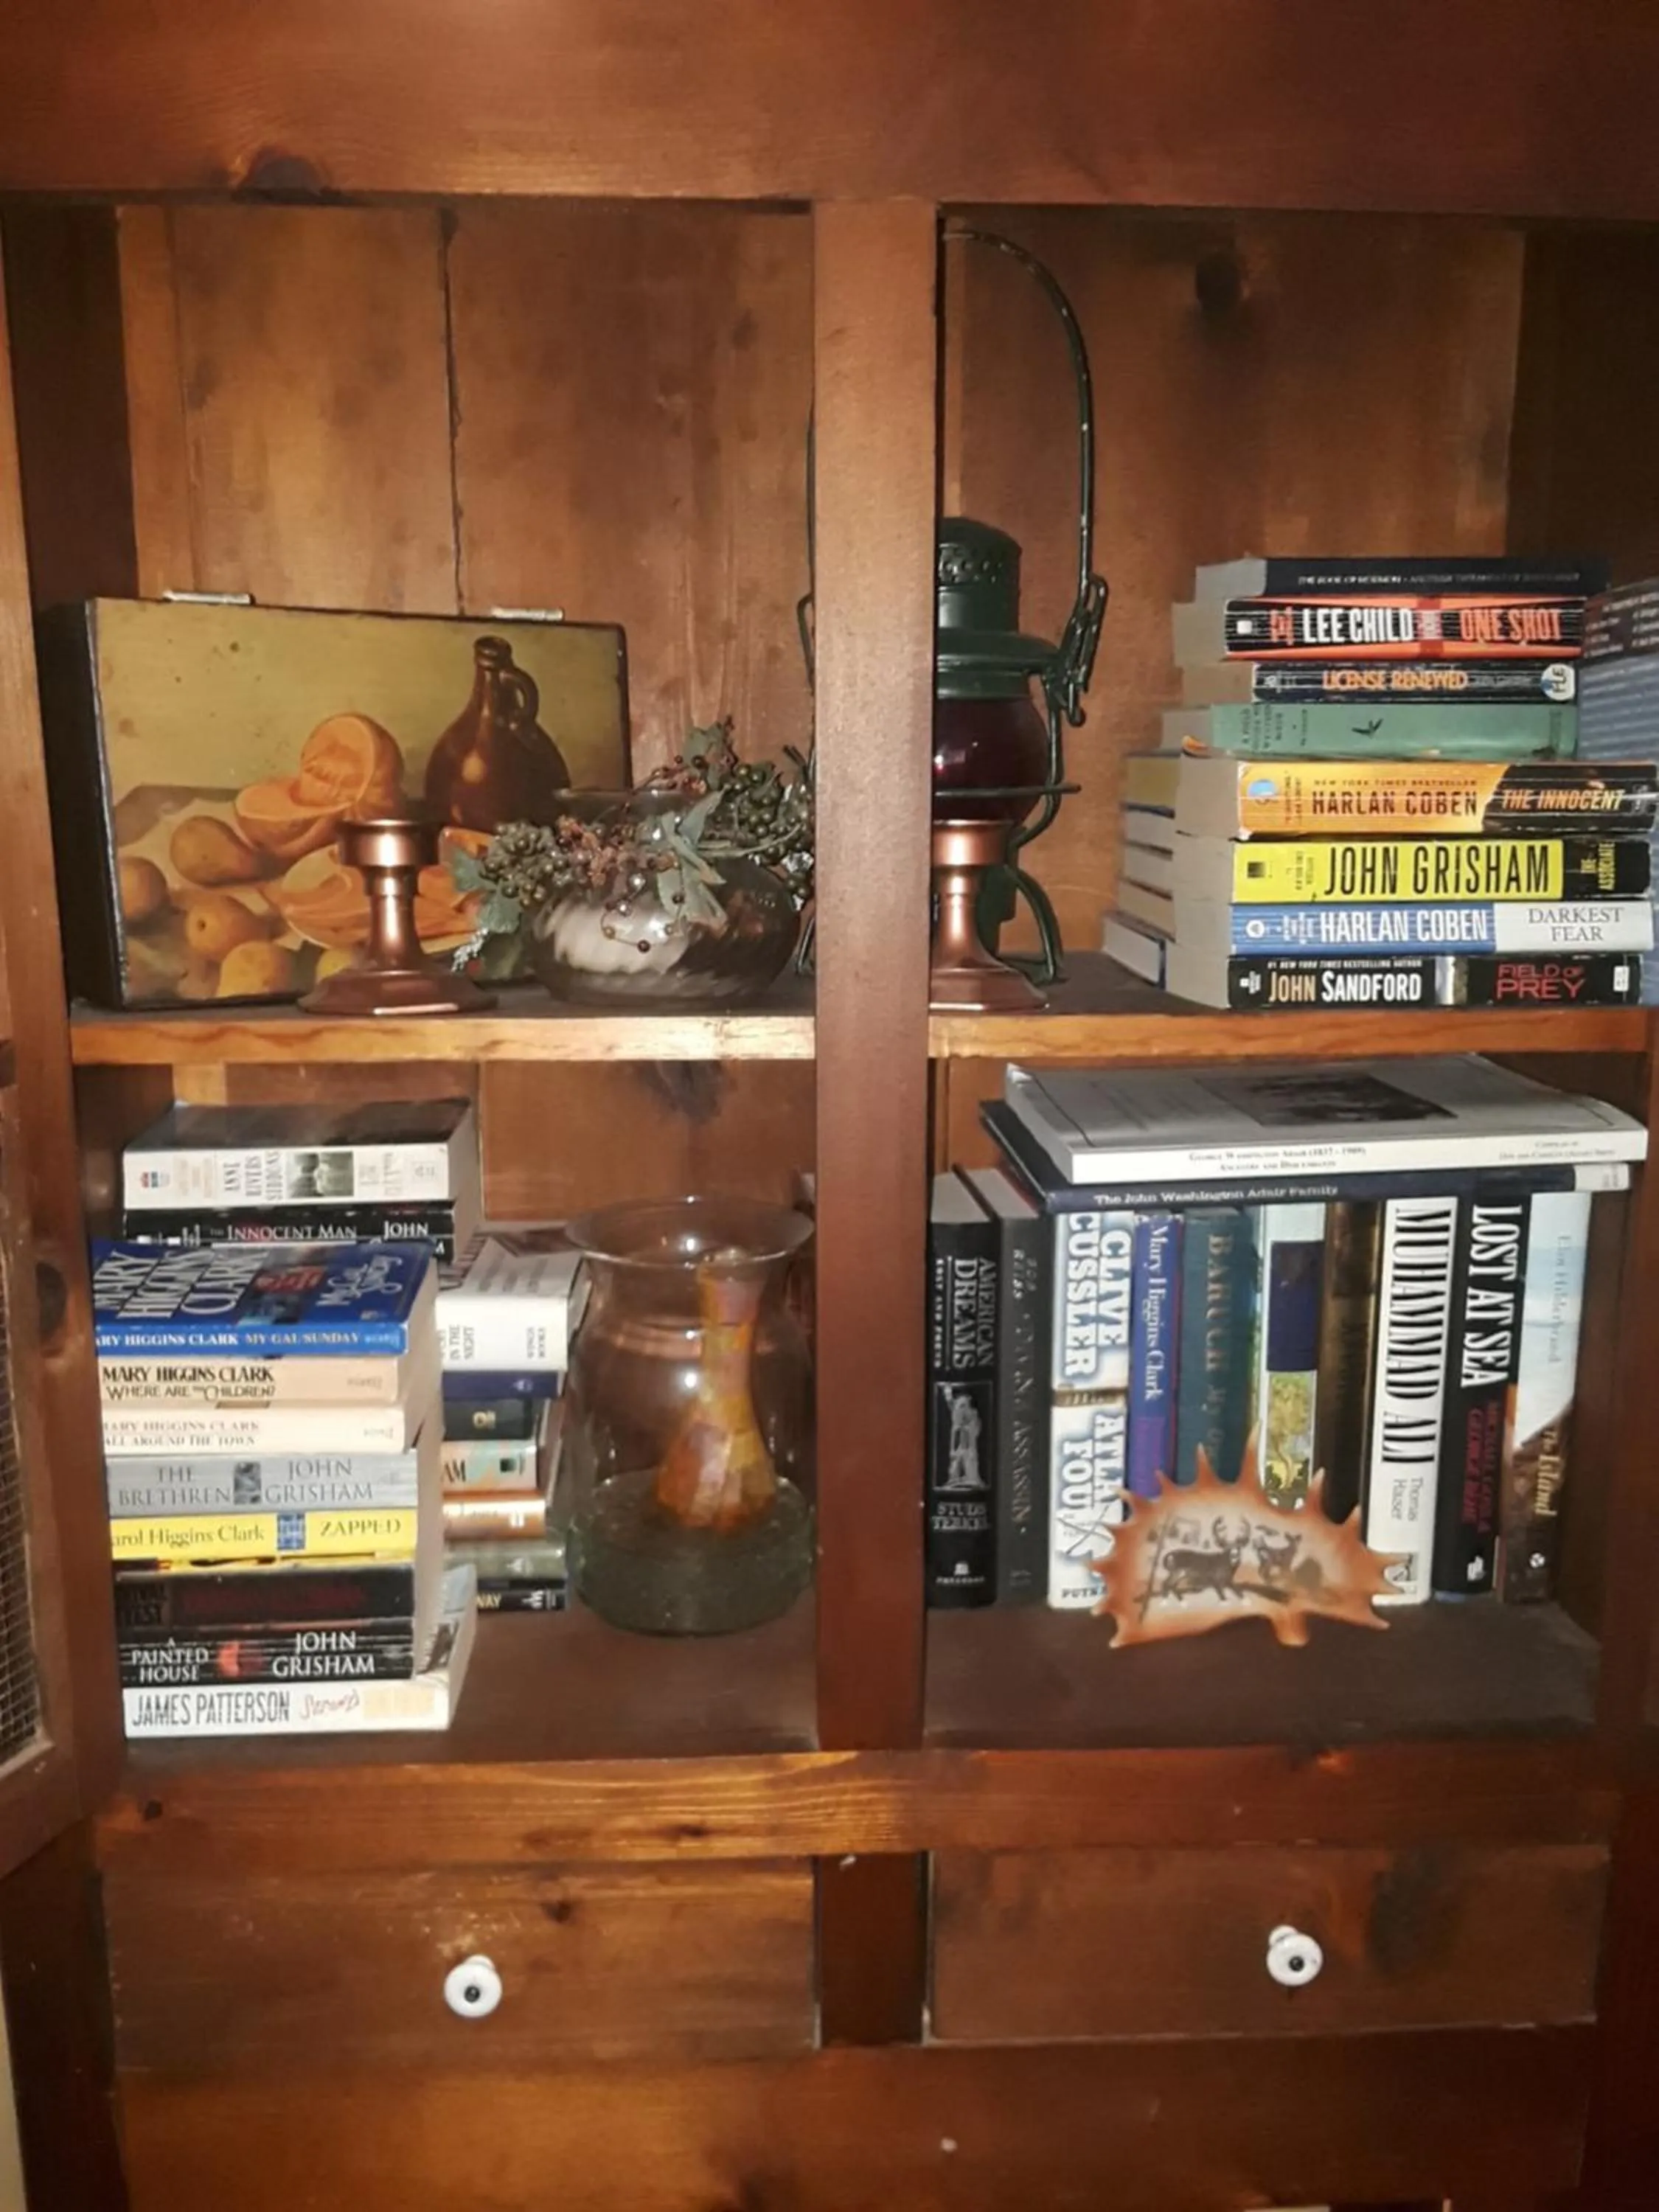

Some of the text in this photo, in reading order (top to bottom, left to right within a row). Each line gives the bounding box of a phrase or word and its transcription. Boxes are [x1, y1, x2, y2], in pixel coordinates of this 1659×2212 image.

[1302, 608, 1346, 644] LEE
[1349, 608, 1414, 643] CHILD
[1459, 609, 1504, 641] ONE
[1508, 609, 1562, 641] SHOT
[1322, 670, 1387, 689] LICENSE
[1391, 669, 1469, 690] RENEWED
[1312, 790, 1395, 815] HARLAN
[1405, 790, 1478, 816] COBEN
[1501, 789, 1534, 810] THE
[1536, 788, 1625, 811] INNOCENT
[1324, 846, 1399, 896] JOHN
[1412, 845, 1548, 894] GRISHAM
[1580, 858, 1596, 874] THE
[1598, 842, 1615, 891] ASSOCIATE
[1321, 911, 1408, 943] HARLAN
[1416, 909, 1488, 942] COBEN
[1528, 907, 1624, 924] DARKEST
[1551, 925, 1604, 942] FEAR
[1498, 964, 1560, 978] FIELD
[1268, 971, 1316, 1002] JOHN
[1321, 970, 1422, 1003] SANDFORD
[1496, 978, 1586, 999] PREY
[1093, 1194, 1122, 1206] The
[1125, 1192, 1158, 1204] John
[1160, 1189, 1244, 1203] Washington
[1289, 1185, 1338, 1196] Family
[227, 1224, 313, 1240] INNOCENT
[318, 1223, 358, 1240] MAN
[383, 1220, 428, 1241] JOHN
[1144, 1225, 1169, 1274] Mary
[94, 1250, 159, 1310] MARY
[116, 1248, 215, 1318] HIGGINS
[181, 1251, 270, 1314] CLARK
[1097, 1229, 1133, 1346] CLIVE
[1064, 1211, 1102, 1377] CUSSLER
[1461, 1204, 1523, 1389] LOST AT SEA
[953, 1259, 978, 1368] DREAMS
[978, 1256, 996, 1366] AMERICAN
[1143, 1277, 1167, 1347] Higgins
[124, 1333, 185, 1346] HIGGINS
[187, 1333, 238, 1346] CLARK
[245, 1333, 269, 1344] MY
[271, 1332, 298, 1344] GAL
[302, 1332, 359, 1343] SUNDAY
[1381, 1207, 1451, 1464] MUHAMMAD ALI
[102, 1366, 274, 1382] MARY HIGGINS CLARK
[1144, 1350, 1165, 1400] Clark
[105, 1385, 161, 1400] WHERE
[164, 1385, 192, 1397] ARE
[203, 1384, 276, 1402] CHILDREN?
[144, 1421, 206, 1431] HIGGINS
[209, 1420, 260, 1430] CLARK
[105, 1436, 255, 1447] ALL AROUND THE TOWN
[157, 1465, 196, 1483] THE
[288, 1457, 353, 1481] JOHN
[1062, 1439, 1093, 1510] FOU
[118, 1487, 232, 1506] BRETHREN
[264, 1483, 374, 1505] GRISHAM
[1534, 1453, 1562, 1517] Island
[937, 1502, 986, 1516] STUDS
[1391, 1478, 1408, 1521] Hauser
[1407, 1477, 1424, 1522] Thomas
[319, 1518, 402, 1537] ZAPPED
[931, 1516, 992, 1530] TERKEL
[149, 1527, 215, 1549] Higgins
[217, 1524, 265, 1542] Clark
[166, 1636, 176, 1648] A
[294, 1630, 357, 1655] JOHN
[131, 1646, 210, 1666] PAINTED
[272, 1654, 375, 1677] GRISHAM
[139, 1664, 200, 1684] HOUSE
[132, 1692, 192, 1727] JAMES
[195, 1690, 291, 1724] PATTERSON
